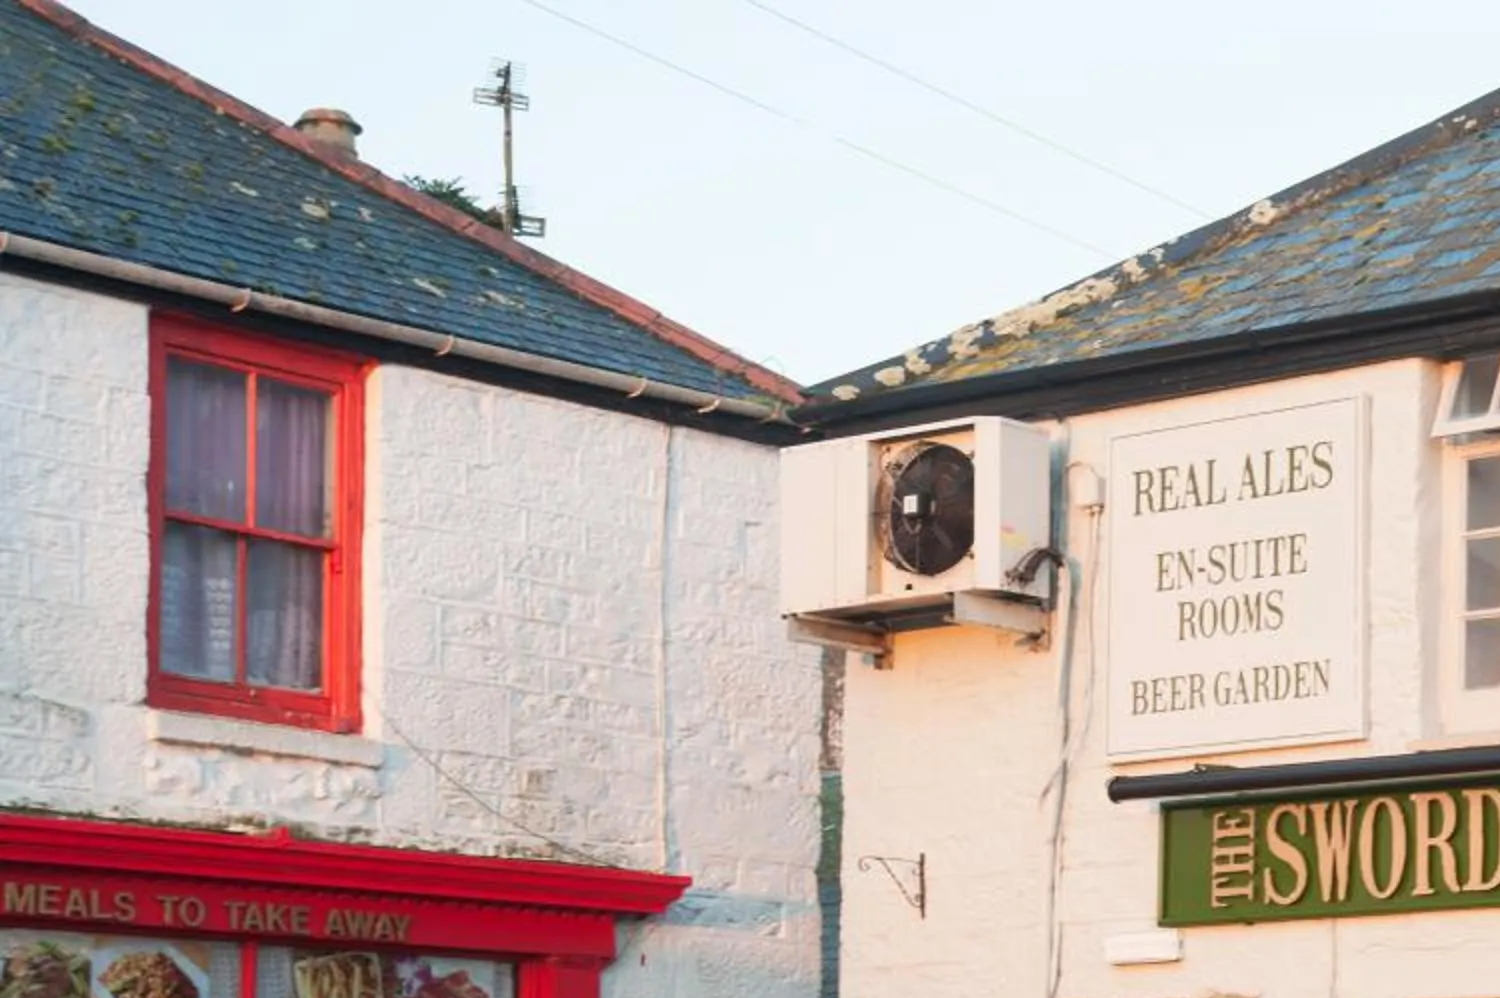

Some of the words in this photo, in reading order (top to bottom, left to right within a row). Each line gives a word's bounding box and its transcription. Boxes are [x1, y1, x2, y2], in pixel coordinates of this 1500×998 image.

[1133, 459, 1227, 517] REAL
[1238, 441, 1333, 501] ALES
[1156, 533, 1308, 592] EN-SUITE
[1178, 589, 1285, 641] ROOMS
[1131, 673, 1206, 716] BEER
[1213, 658, 1331, 707] GARDEN
[1211, 808, 1256, 908] THE
[1, 881, 137, 922] MEALS
[157, 894, 206, 927] TO
[223, 900, 311, 936] TAKE
[324, 908, 412, 941] AWAY
